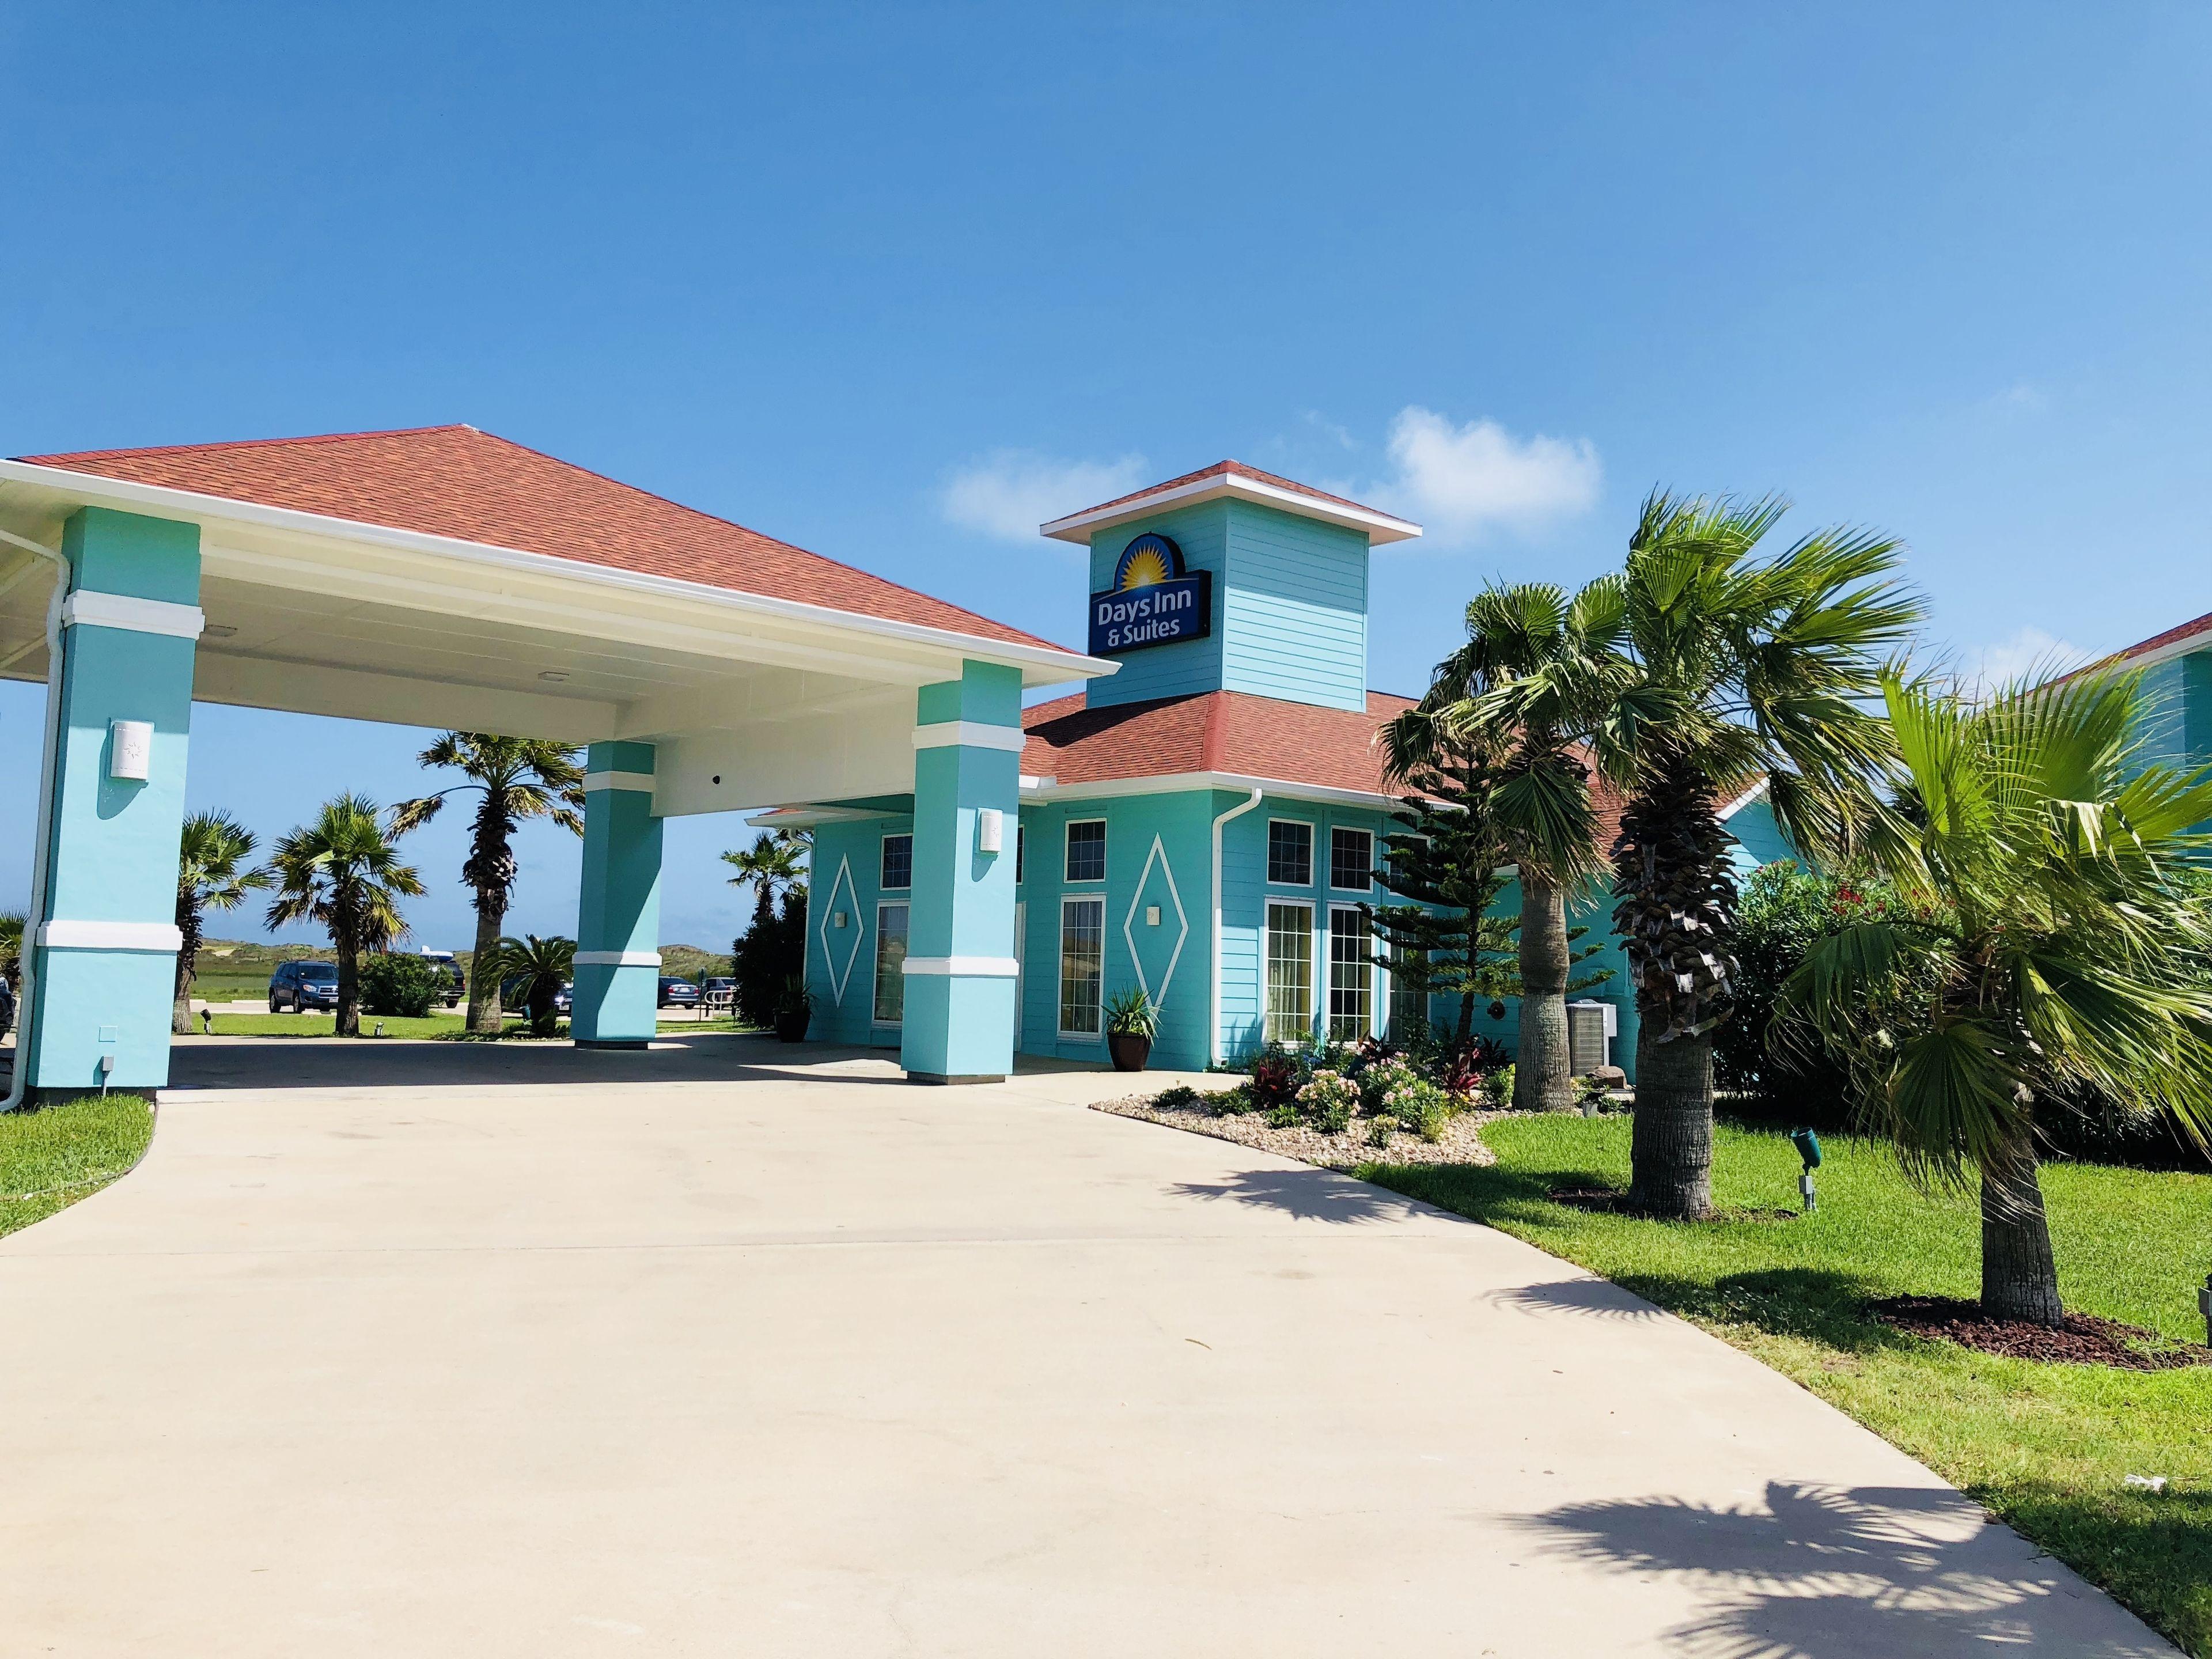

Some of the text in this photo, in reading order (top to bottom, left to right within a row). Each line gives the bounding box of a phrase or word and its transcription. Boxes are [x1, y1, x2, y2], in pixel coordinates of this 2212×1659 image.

[1099, 590, 1191, 626] Days Inn
[1108, 619, 1180, 647] & Suites
